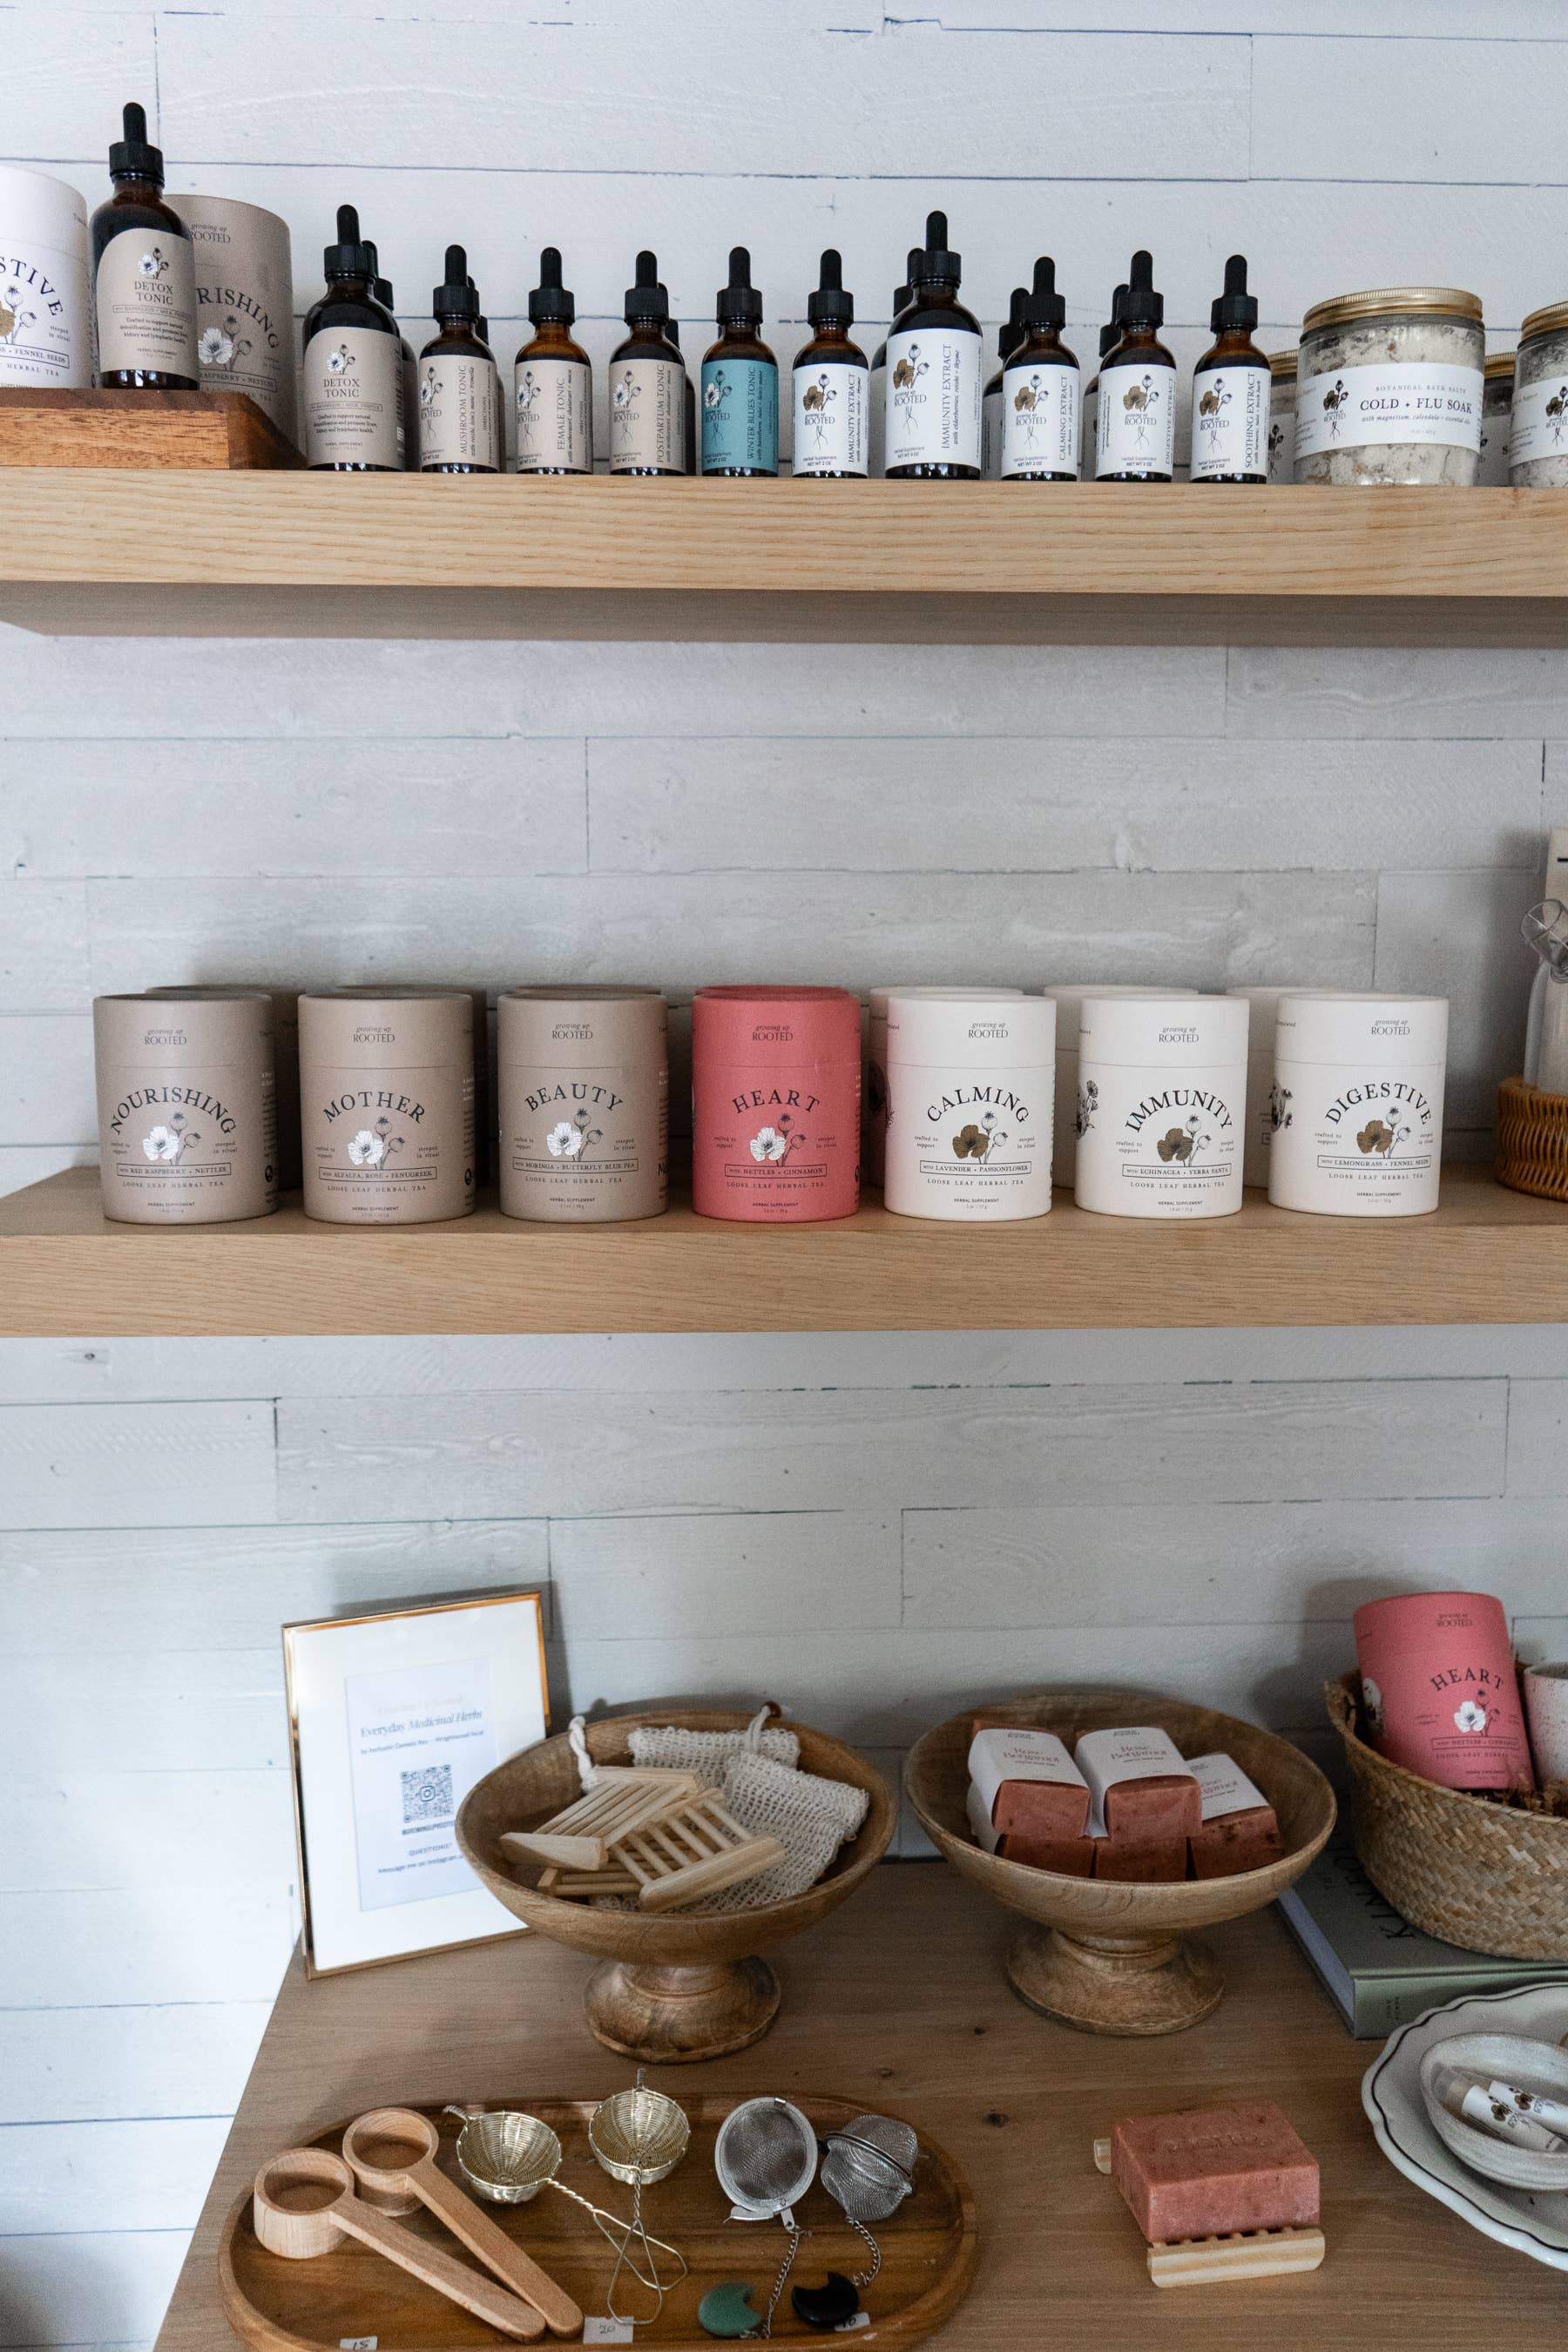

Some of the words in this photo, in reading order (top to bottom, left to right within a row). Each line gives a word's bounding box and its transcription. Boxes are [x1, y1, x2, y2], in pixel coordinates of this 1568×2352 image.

[134, 280, 173, 295] DETOX
[135, 292, 173, 305] TONIC
[15, 348, 44, 360] FENNEL
[7, 362, 40, 374] HERBAL
[45, 368, 60, 377] TEA
[943, 343, 951, 390] EXTRACT
[323, 378, 361, 388] DETOX
[656, 364, 665, 397] TONIC
[326, 389, 360, 398] TONIC
[556, 378, 564, 413] TONIC
[894, 395, 927, 407] ROOTED
[1247, 372, 1255, 414] EXTRACT
[747, 398, 755, 423] BLUES
[1360, 398, 1399, 411] COLD
[1416, 397, 1443, 409] FLU
[1446, 399, 1473, 415] SOAK
[804, 416, 835, 425] ROOTED
[942, 394, 950, 449] IMMUNITY
[1016, 416, 1047, 426] ROOTED
[1125, 416, 1157, 426] ROOTED
[1200, 421, 1230, 431] ROOTED
[557, 415, 565, 449] FEMALE
[656, 401, 665, 463] POSTPARTUM
[747, 425, 755, 459] WINTER
[1246, 416, 1254, 468] SOOTHING
[353, 1033, 395, 1043] ROOTED
[551, 1031, 593, 1040] ROOTED
[752, 1031, 794, 1042] ROOTED
[968, 1029, 1009, 1038] ROOTED
[1159, 1034, 1200, 1043] ROOTED
[1371, 1026, 1410, 1036] ROOTED
[144, 1036, 187, 1045] ROOTED
[524, 1083, 624, 1112] BEAUTY
[732, 1089, 821, 1114] HEART
[927, 1086, 1029, 1124] CALMING
[1325, 1082, 1432, 1125] DIGESTIVE
[111, 1086, 238, 1136] NOURISHING
[322, 1091, 426, 1125] MOTHER
[1125, 1089, 1233, 1133] IMMUNITY
[1430, 1667, 1504, 1692] HEART
[361, 1721, 405, 1738] Everyday
[409, 1713, 455, 1730] Medicinal
[456, 1709, 483, 1724] Herbs
[353, 2340, 371, 2350] 15
